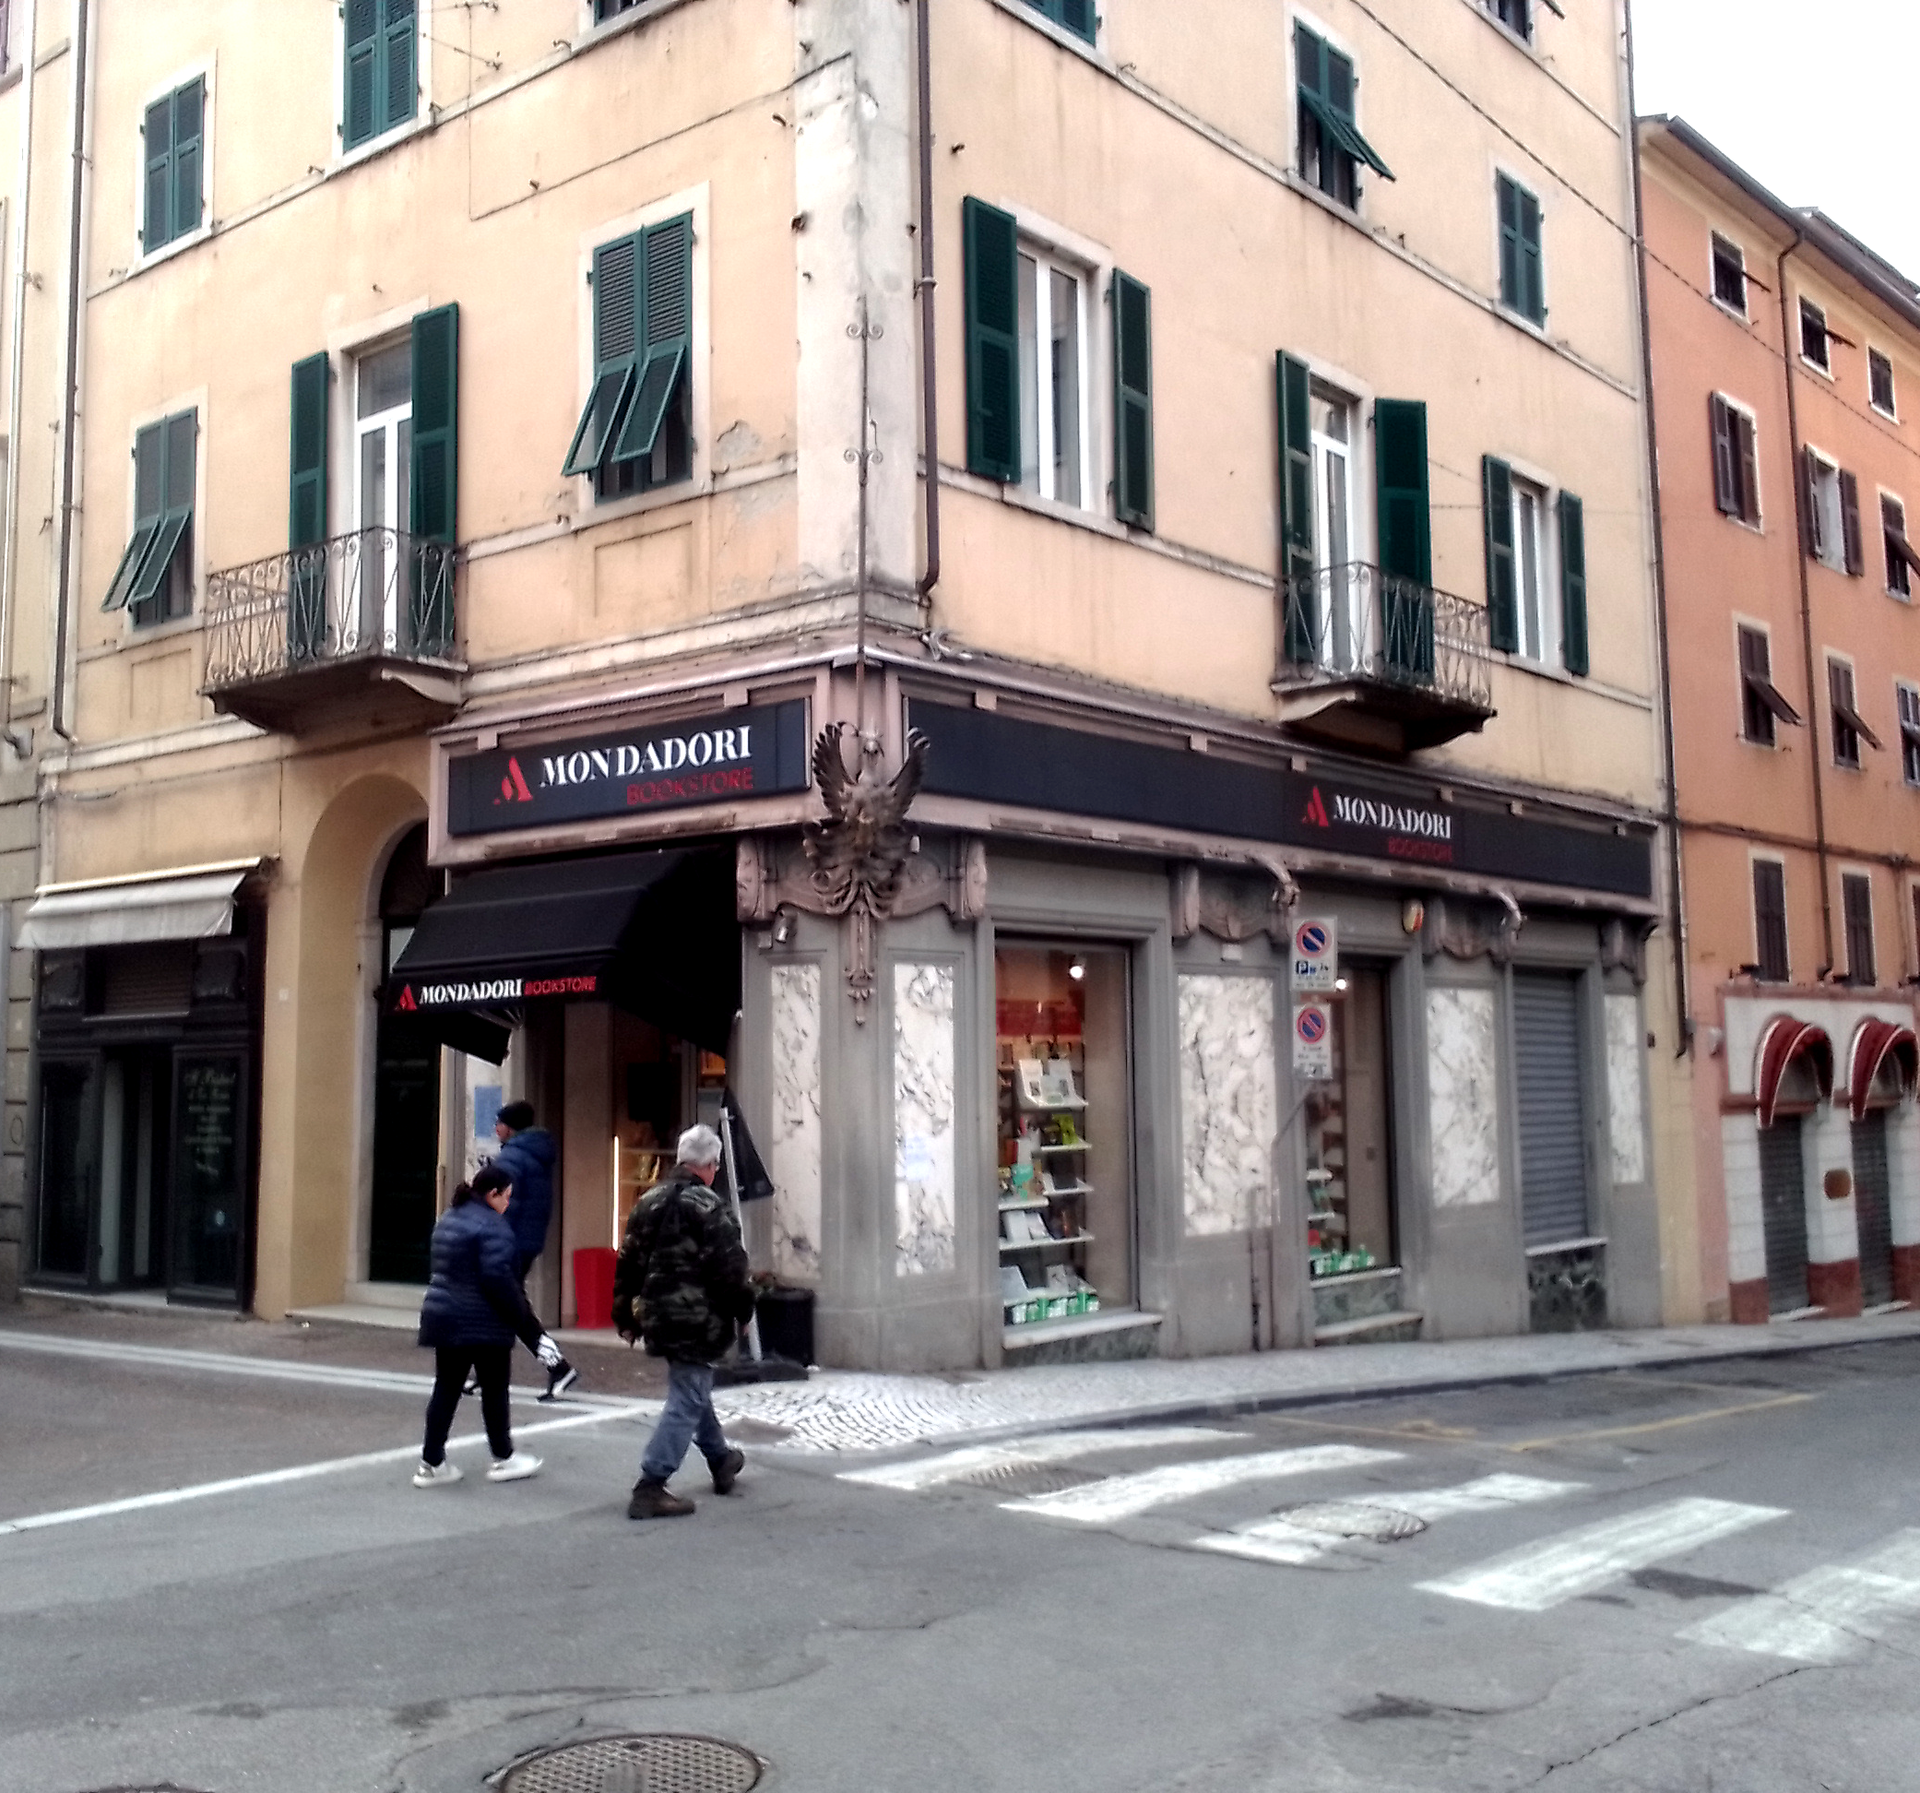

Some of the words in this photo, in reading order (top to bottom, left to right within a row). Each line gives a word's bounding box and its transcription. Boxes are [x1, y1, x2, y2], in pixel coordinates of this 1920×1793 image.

[540, 725, 752, 788] MONDADORI
[626, 767, 754, 806] BOOKSTORE
[1333, 794, 1452, 839] MONDADORI
[419, 978, 522, 1005] MONDADORI
